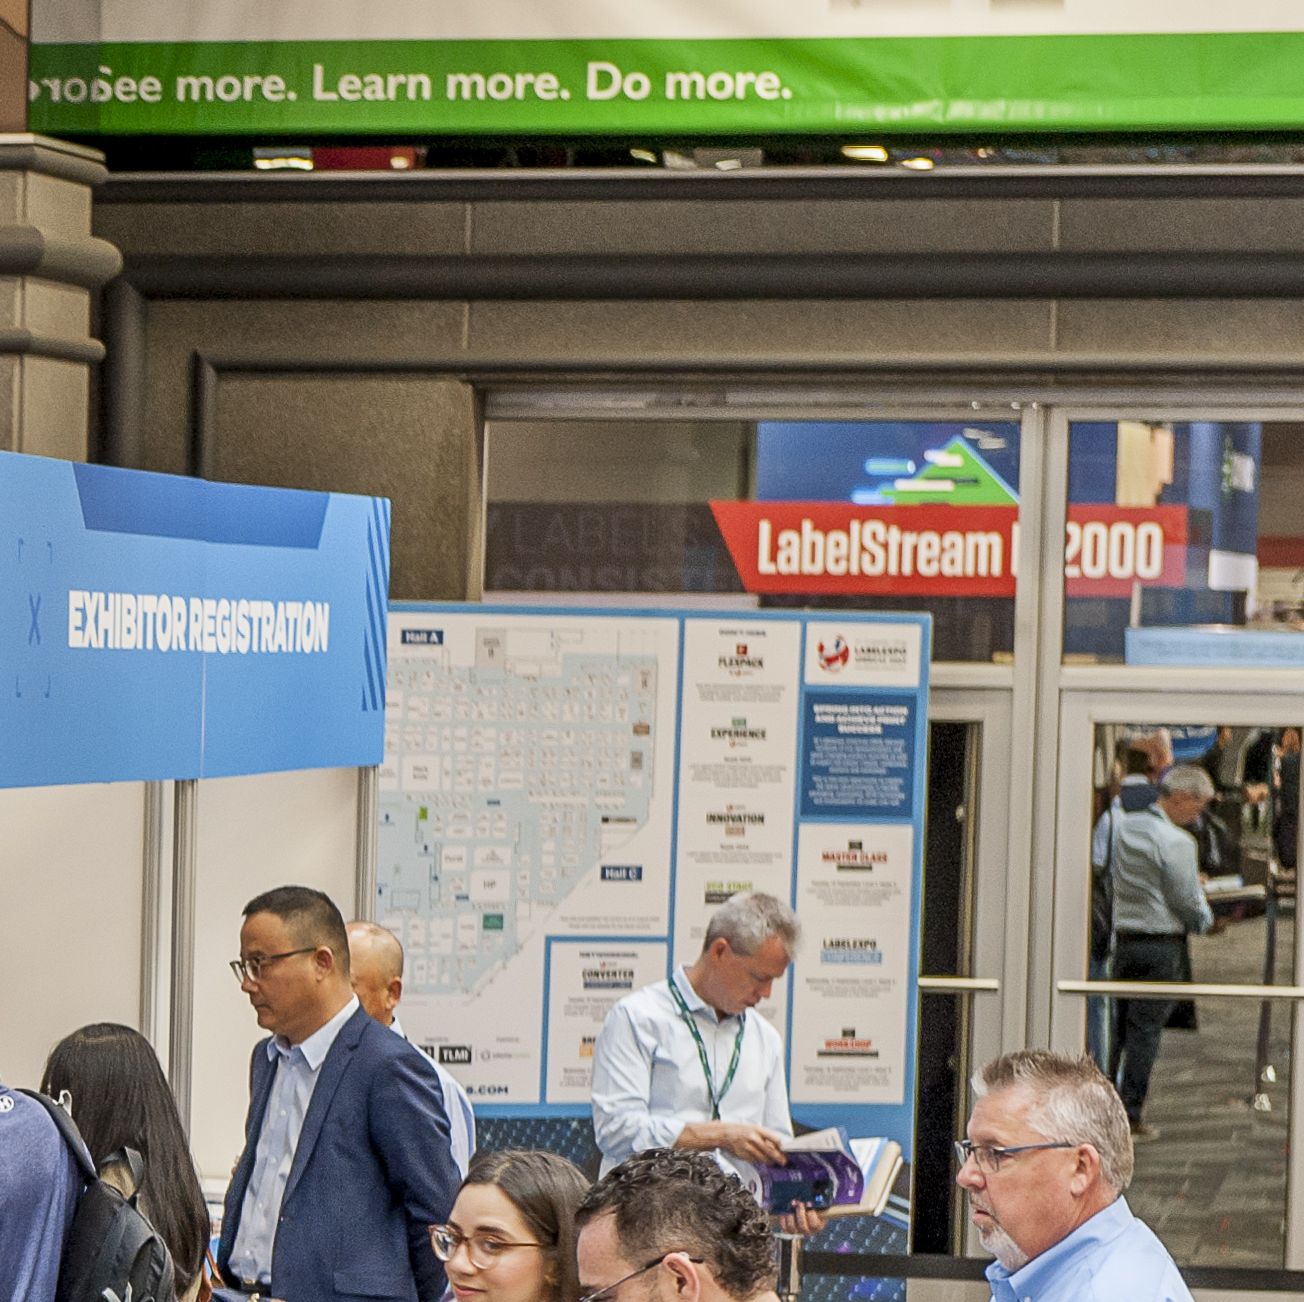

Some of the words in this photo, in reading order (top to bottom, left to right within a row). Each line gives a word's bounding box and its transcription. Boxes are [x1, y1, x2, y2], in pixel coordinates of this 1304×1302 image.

[176, 74, 298, 102] more.
[312, 63, 432, 102] Learn
[446, 72, 571, 101] more.
[586, 61, 652, 101] Do
[665, 71, 793, 101] more.
[757, 517, 1003, 578] LabelStream
[68, 590, 187, 652] EXHIBITOR
[189, 596, 330, 654] REGISTRATION
[405, 631, 429, 644] Hall
[430, 632, 439, 644] A
[711, 727, 767, 741] EXPERIENCE
[706, 813, 765, 825] INNOVATION
[605, 867, 629, 880] Hall
[629, 867, 638, 880] C
[582, 969, 634, 980] CONVERTER
[442, 1048, 469, 1062] TLMI
